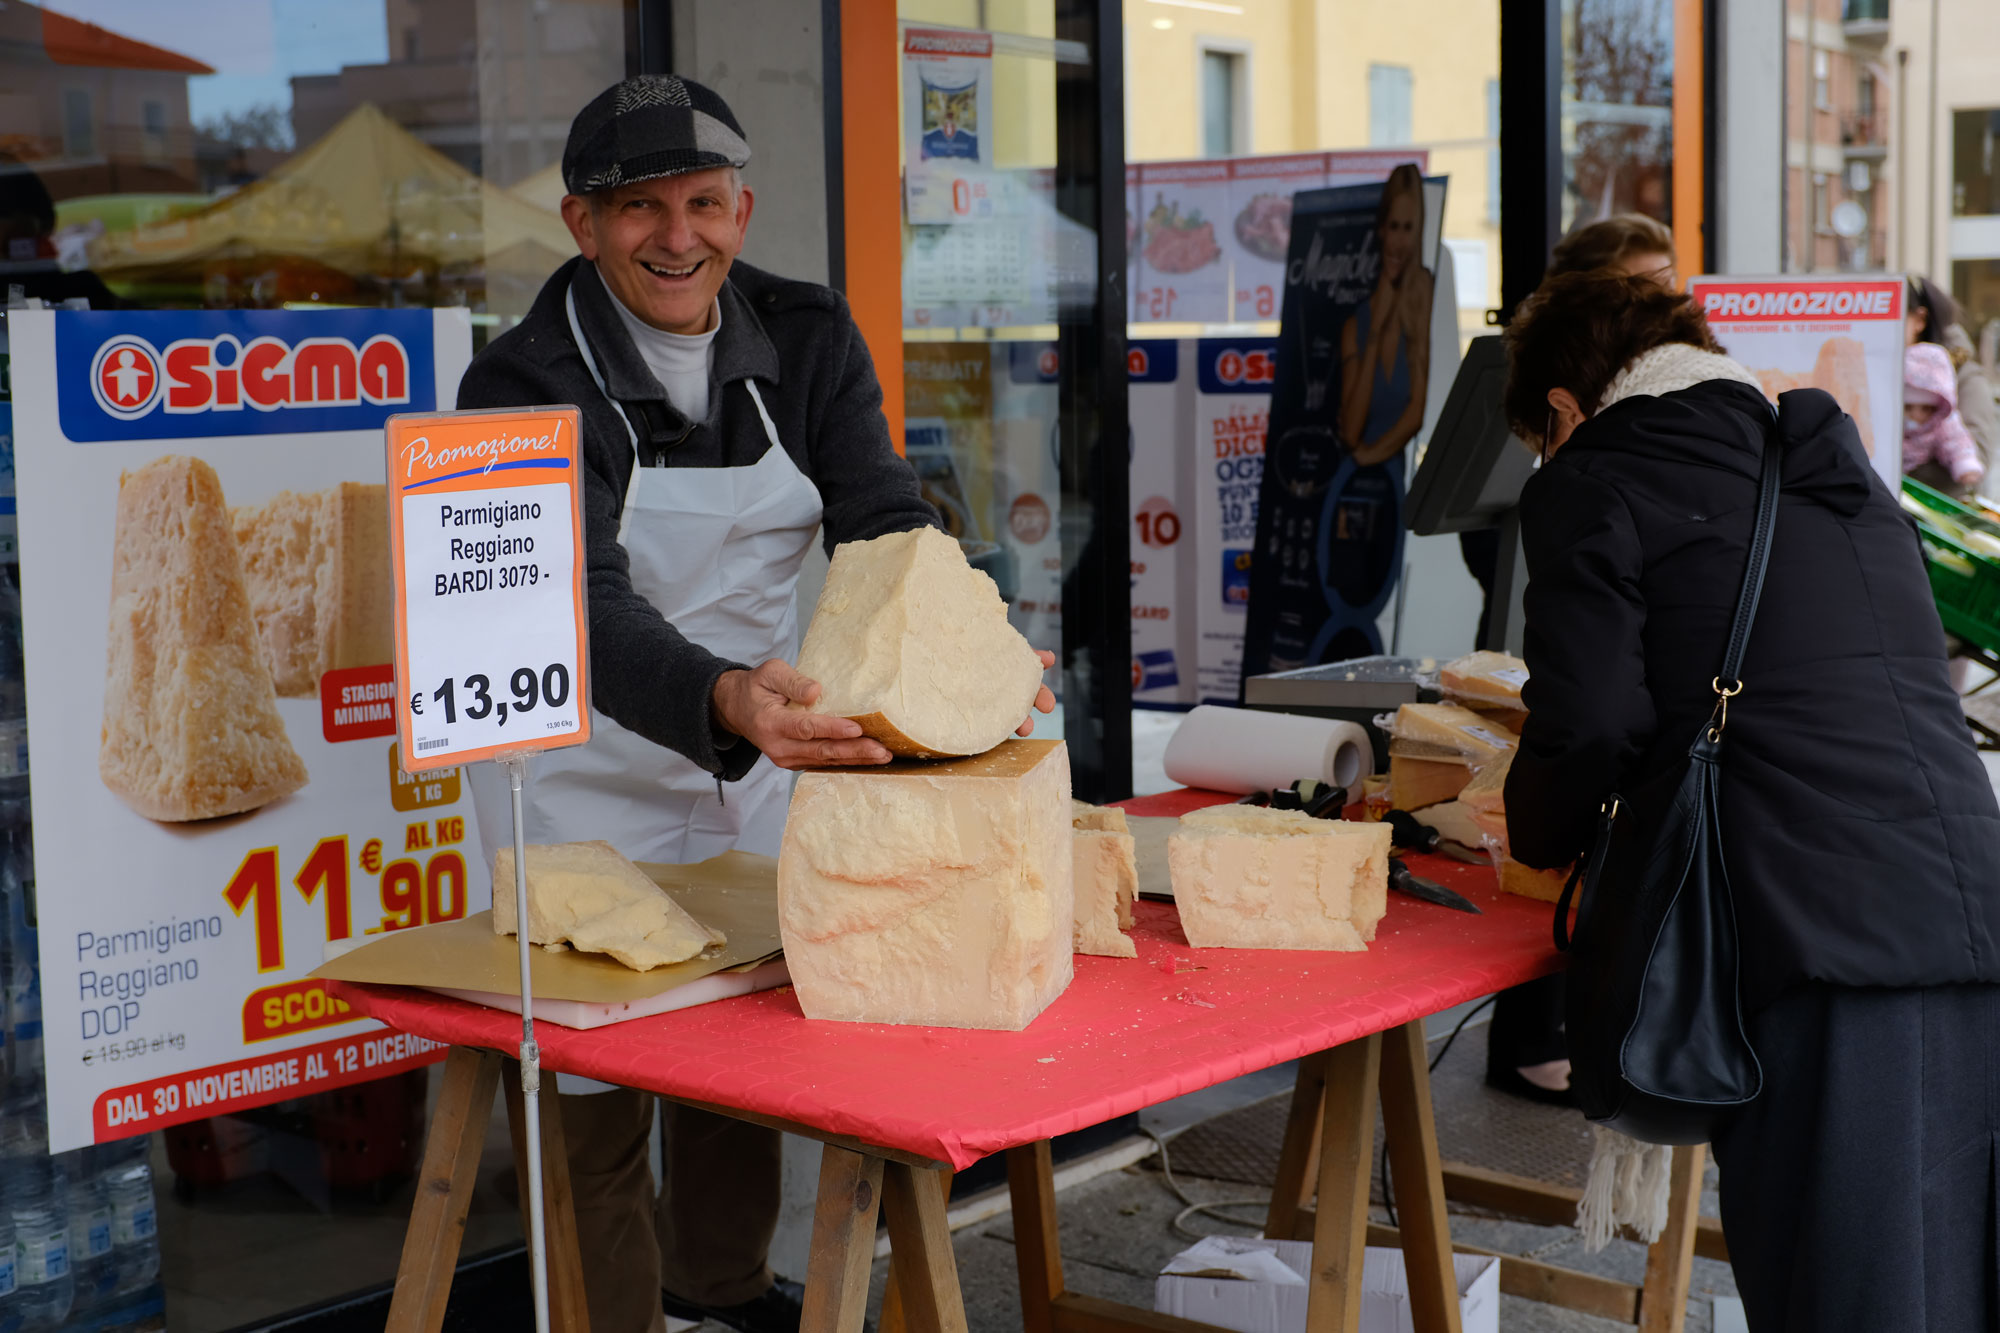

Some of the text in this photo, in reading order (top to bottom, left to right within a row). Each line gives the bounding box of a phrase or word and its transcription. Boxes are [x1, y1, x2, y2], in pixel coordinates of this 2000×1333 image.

[1704, 291, 1893, 316] PROMOZIONE
[401, 419, 562, 477] Promozione!
[441, 502, 541, 528] Parmigiano
[1135, 511, 1181, 546] 10
[450, 534, 534, 563] Reggiano
[435, 568, 493, 596] BARDI
[499, 564, 539, 589] 3079
[410, 662, 570, 727] € 13,90
[334, 702, 392, 726] MINIMA
[412, 783, 442, 803] 1 KG
[405, 816, 464, 852] AL KG
[221, 834, 352, 974] 11
[359, 838, 383, 875] €
[78, 916, 222, 962] Parmigiano
[80, 958, 199, 1001] Reggiano
[82, 1001, 140, 1040] DOP
[106, 1093, 149, 1127] DAL
[153, 1084, 180, 1116] 30
[185, 1058, 300, 1108] NOVEMBRE
[305, 1053, 329, 1081] AL
[334, 1045, 359, 1074] 12
